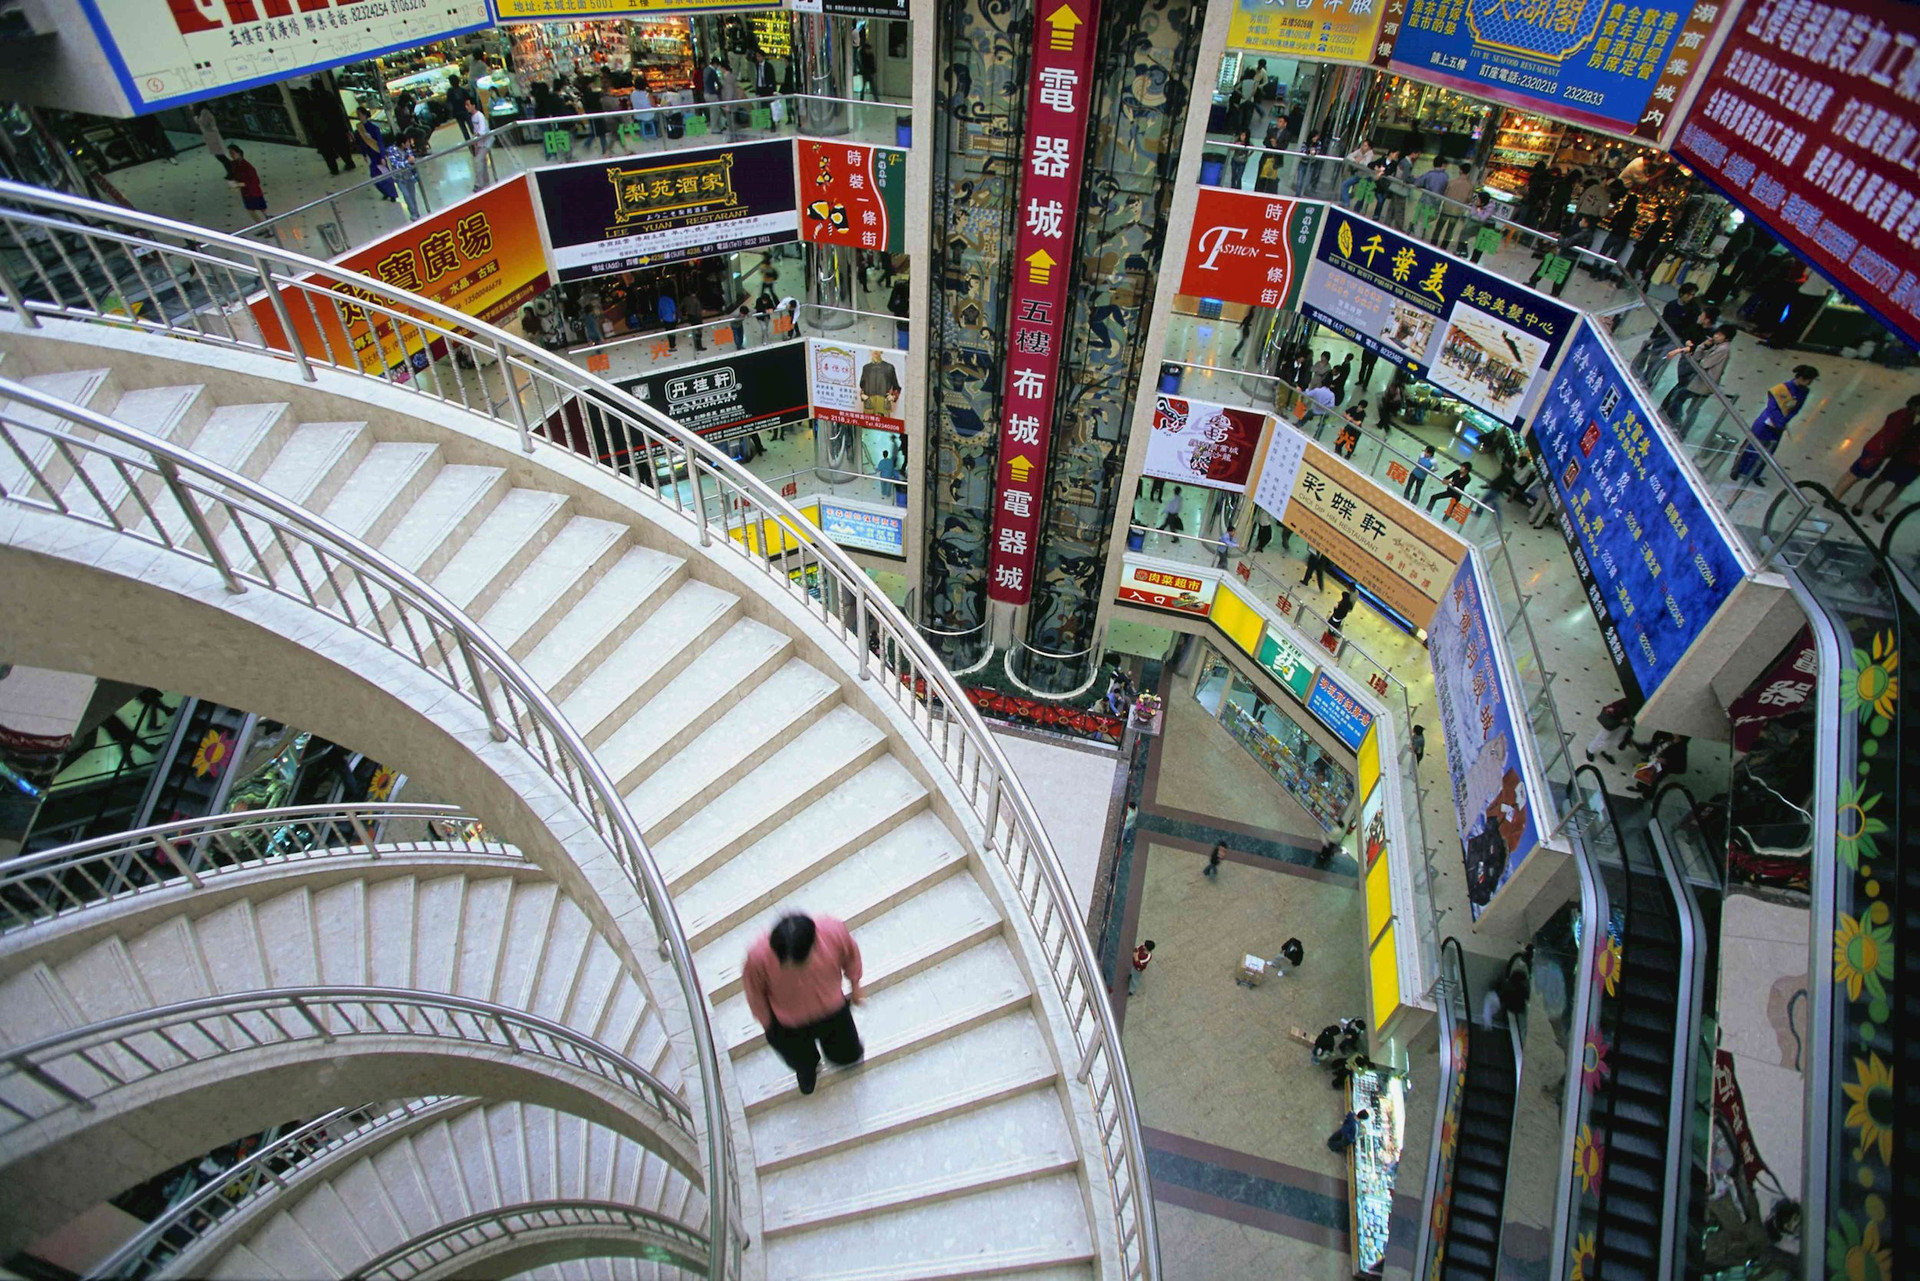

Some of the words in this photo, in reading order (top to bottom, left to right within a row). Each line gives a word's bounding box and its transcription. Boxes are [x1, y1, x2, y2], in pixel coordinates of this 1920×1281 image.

[1492, 54, 1519, 67] SEAFOOD
[1520, 60, 1561, 77] RESTAURANT
[1602, 6, 1642, 72] 全年酒席
[1637, 11, 1679, 80] 港商經營
[1430, 51, 1468, 72] 請上五樓
[1563, 85, 1605, 106] 2322833
[1025, 67, 1079, 240] 電器城
[623, 172, 725, 203] 梨苑酒家
[847, 149, 877, 247] 時裝一條街
[605, 227, 629, 239] LEE
[643, 221, 673, 233] YUAN
[686, 209, 749, 226] RESTARANT
[1260, 203, 1284, 305] 時裝一條街
[1360, 234, 1445, 303] 千葉美
[1015, 299, 1053, 357] 五樓
[1459, 283, 1555, 336] 美容美髮中心
[668, 397, 738, 416] RESTAURANT
[672, 372, 730, 398] 丹桂軒
[1007, 367, 1046, 446] 布城
[1298, 492, 1313, 506] CHOI
[1314, 503, 1325, 514] DIP
[1326, 510, 1338, 523] HIN
[1338, 521, 1379, 553] RESTAURANT
[1302, 471, 1387, 541] 彩蝶軒
[995, 489, 1033, 591] 電器城
[1130, 591, 1166, 605] 入口
[1148, 572, 1201, 591] 肉菜超市
